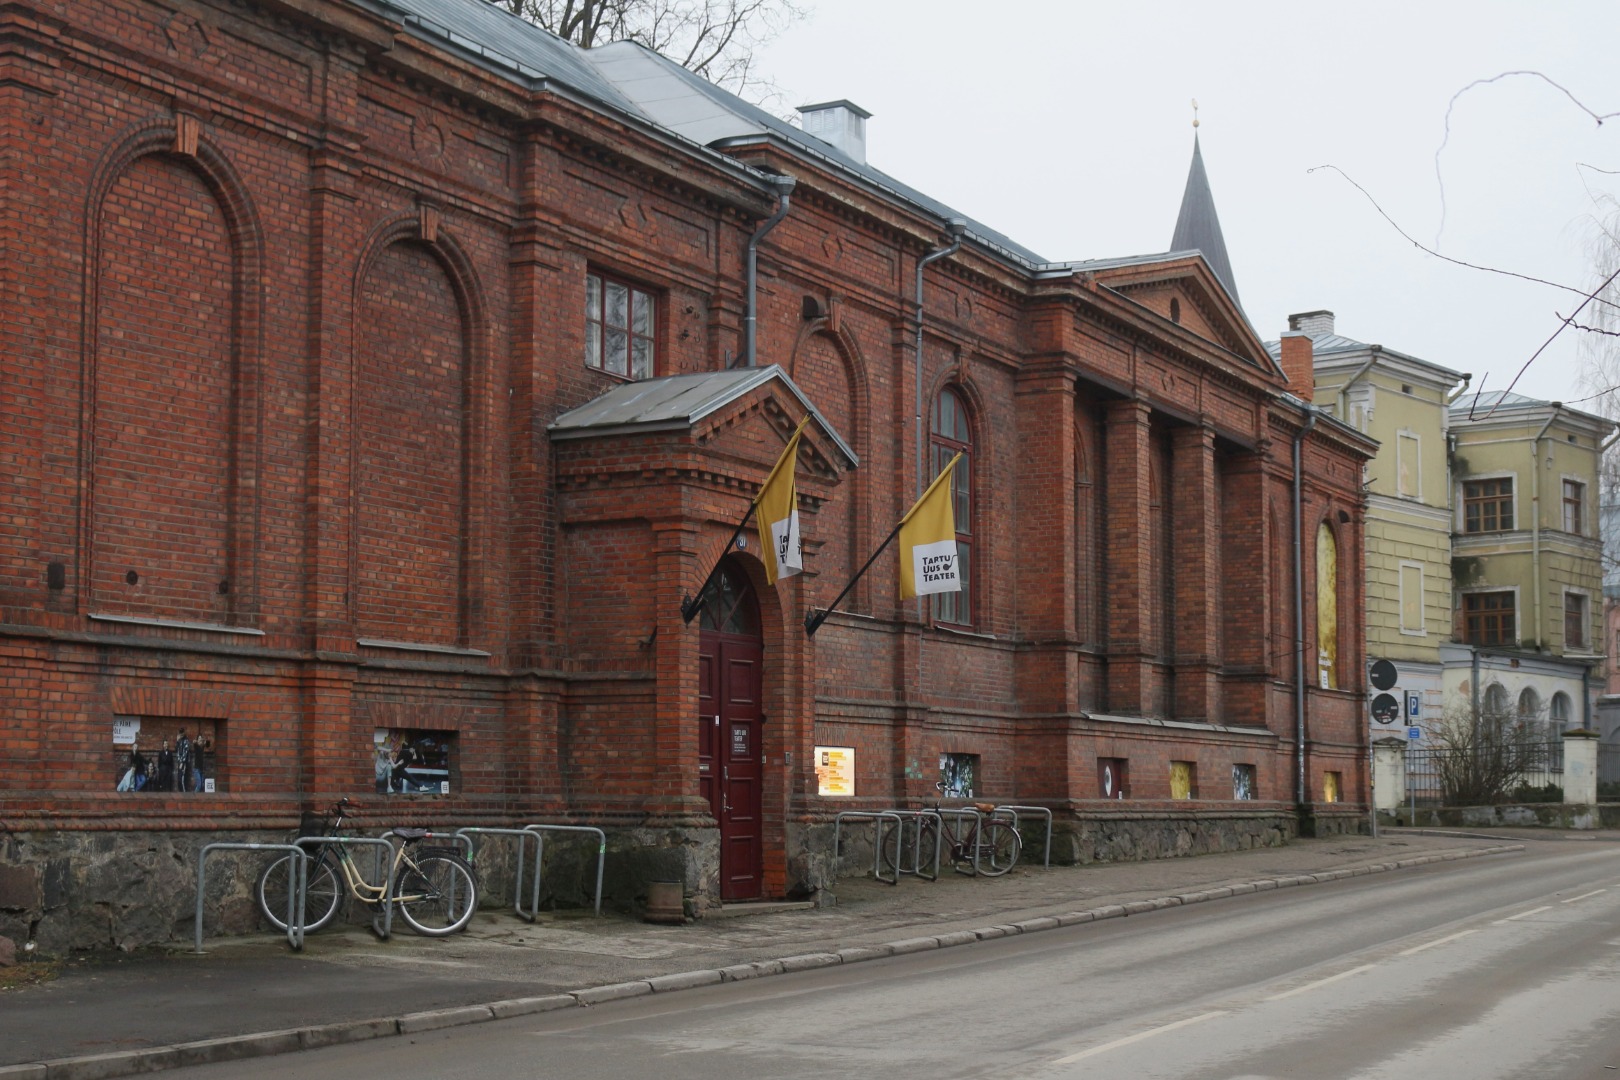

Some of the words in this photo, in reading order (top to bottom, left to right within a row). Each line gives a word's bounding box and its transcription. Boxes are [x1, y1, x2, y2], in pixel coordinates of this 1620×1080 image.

[922, 555, 951, 565] TARTU
[923, 565, 941, 574] UUS
[923, 572, 956, 582] TEATER
[1411, 698, 1417, 714] P
